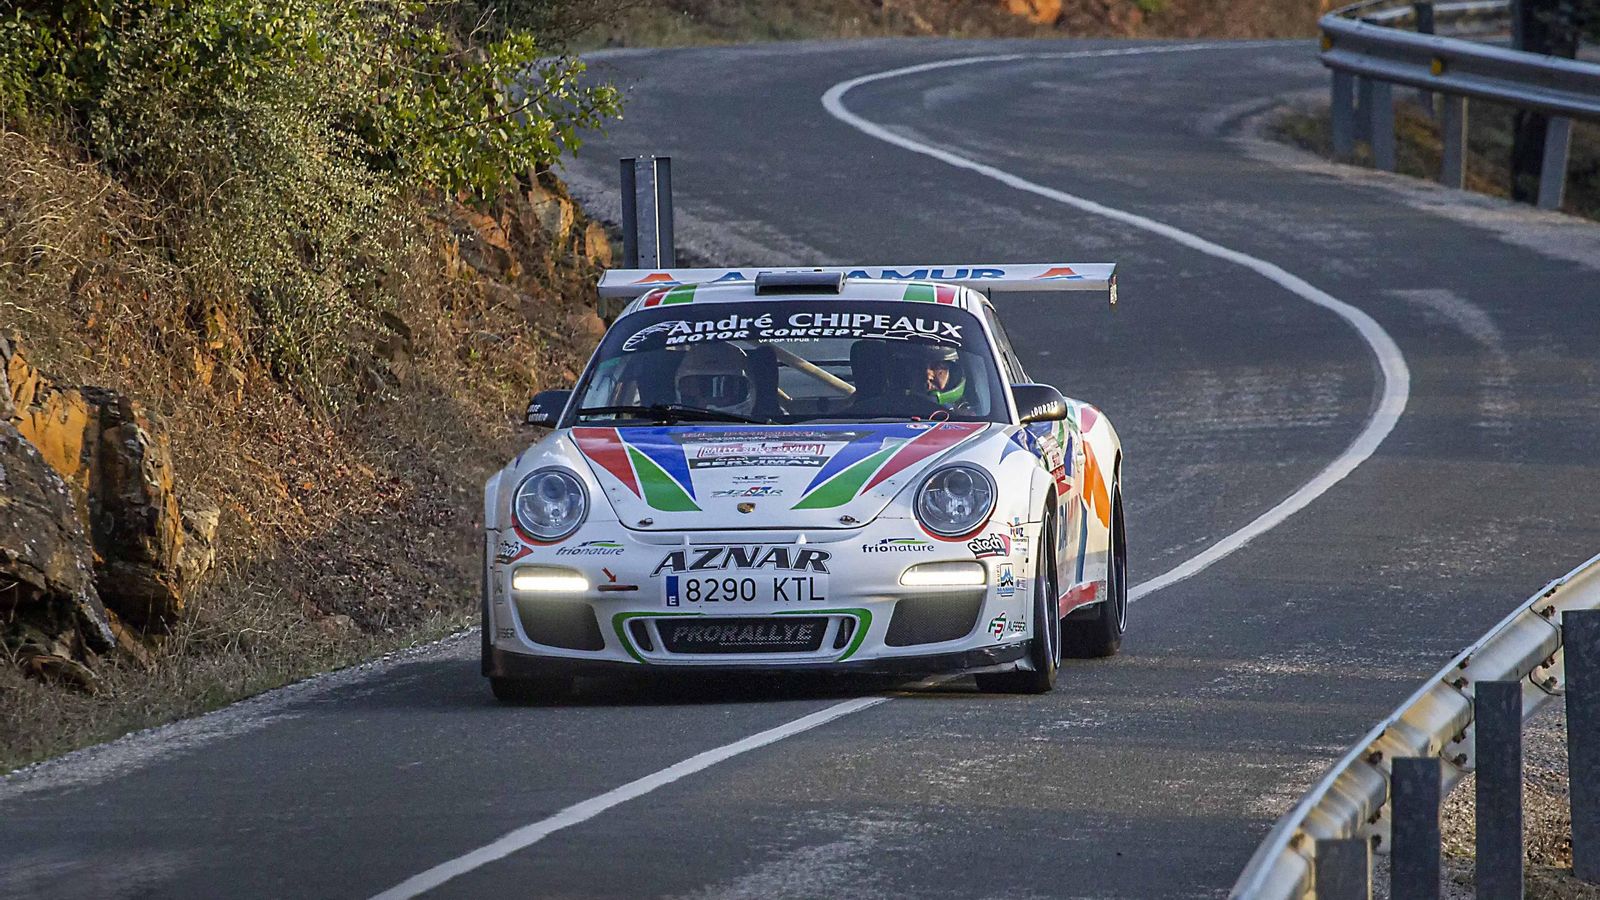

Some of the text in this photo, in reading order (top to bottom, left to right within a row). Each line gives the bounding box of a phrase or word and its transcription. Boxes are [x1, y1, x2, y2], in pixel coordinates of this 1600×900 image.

[666, 313, 963, 339] André CHIPEAUX
[665, 330, 749, 345] MOTOR
[759, 328, 865, 338] CONCEPT
[1031, 400, 1058, 418] LOURDES
[556, 547, 625, 556] frionature
[862, 543, 935, 553] frionature
[650, 546, 833, 577] AZNAR
[686, 577, 825, 602] 8290 KTL
[669, 596, 677, 606] E
[672, 623, 815, 643] PRORALLYE
